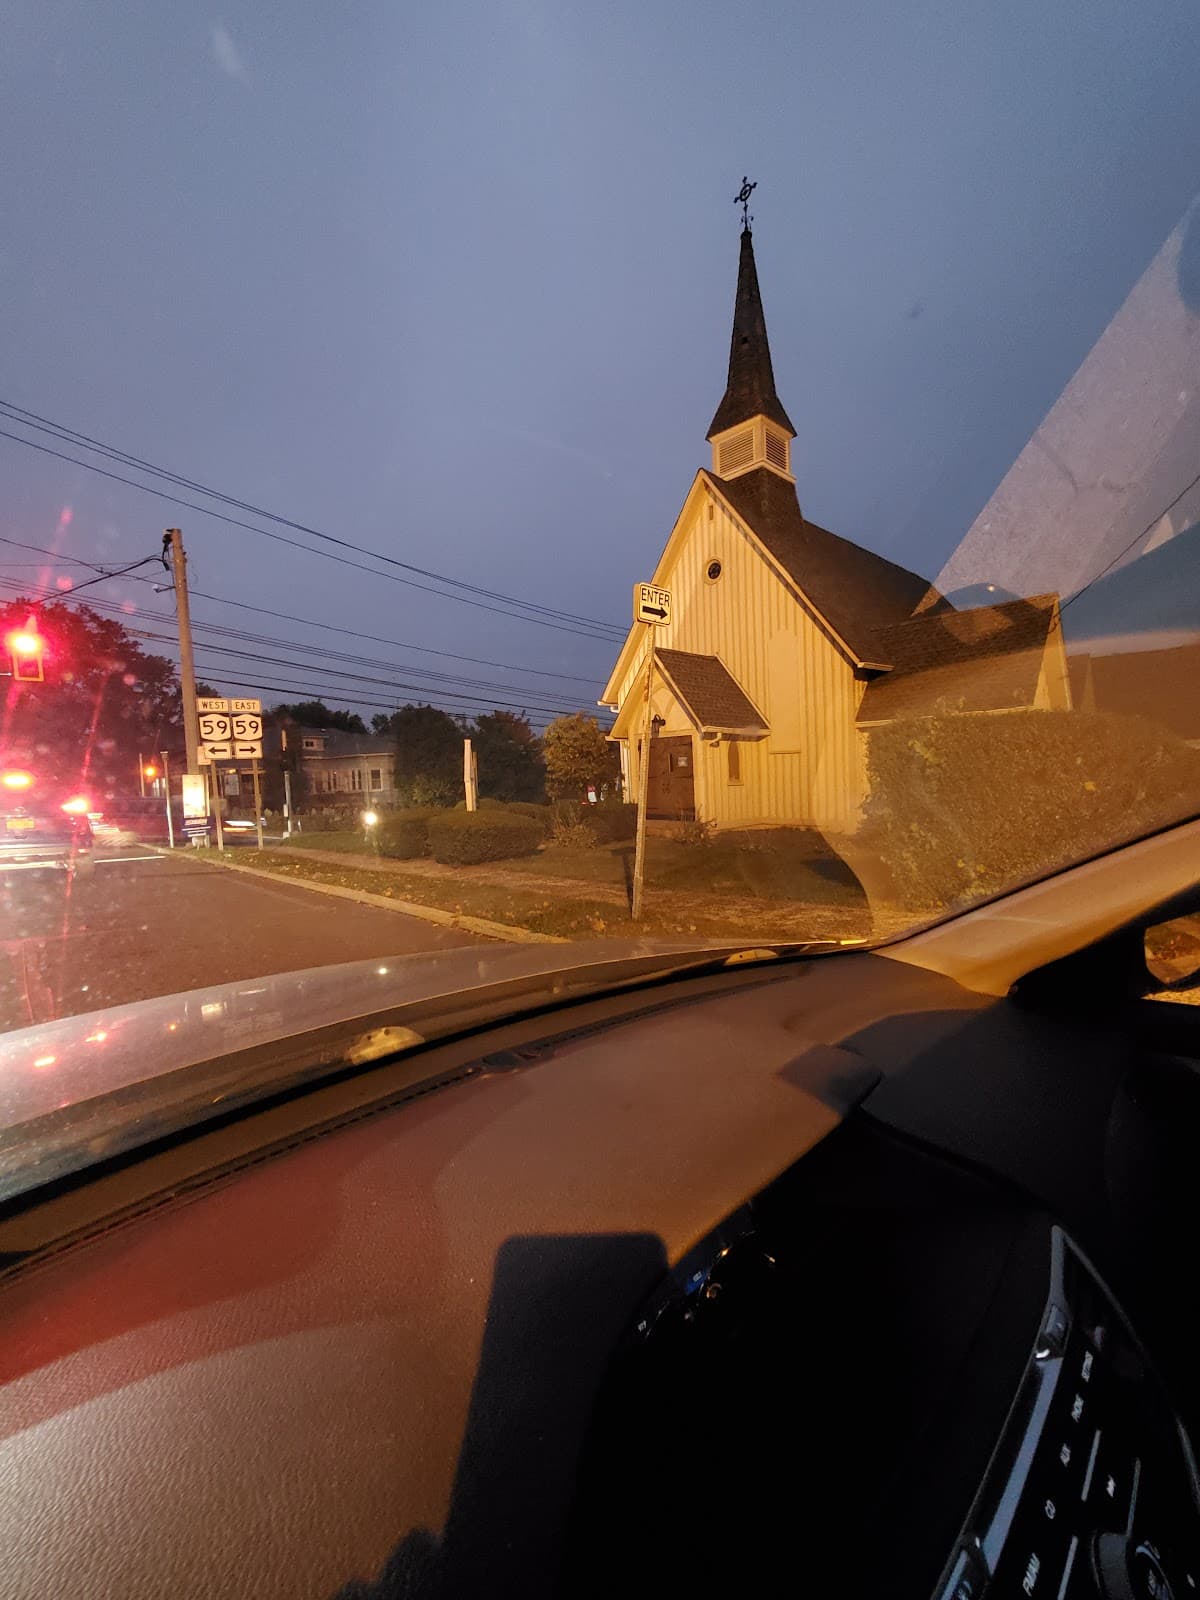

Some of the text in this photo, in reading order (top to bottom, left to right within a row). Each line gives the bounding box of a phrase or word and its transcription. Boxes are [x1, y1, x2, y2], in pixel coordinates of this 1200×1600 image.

[641, 587, 670, 607] ENTER
[201, 701, 225, 710] WEST
[234, 701, 256, 710] EAST
[202, 720, 228, 735] 59
[235, 720, 259, 735] 59
